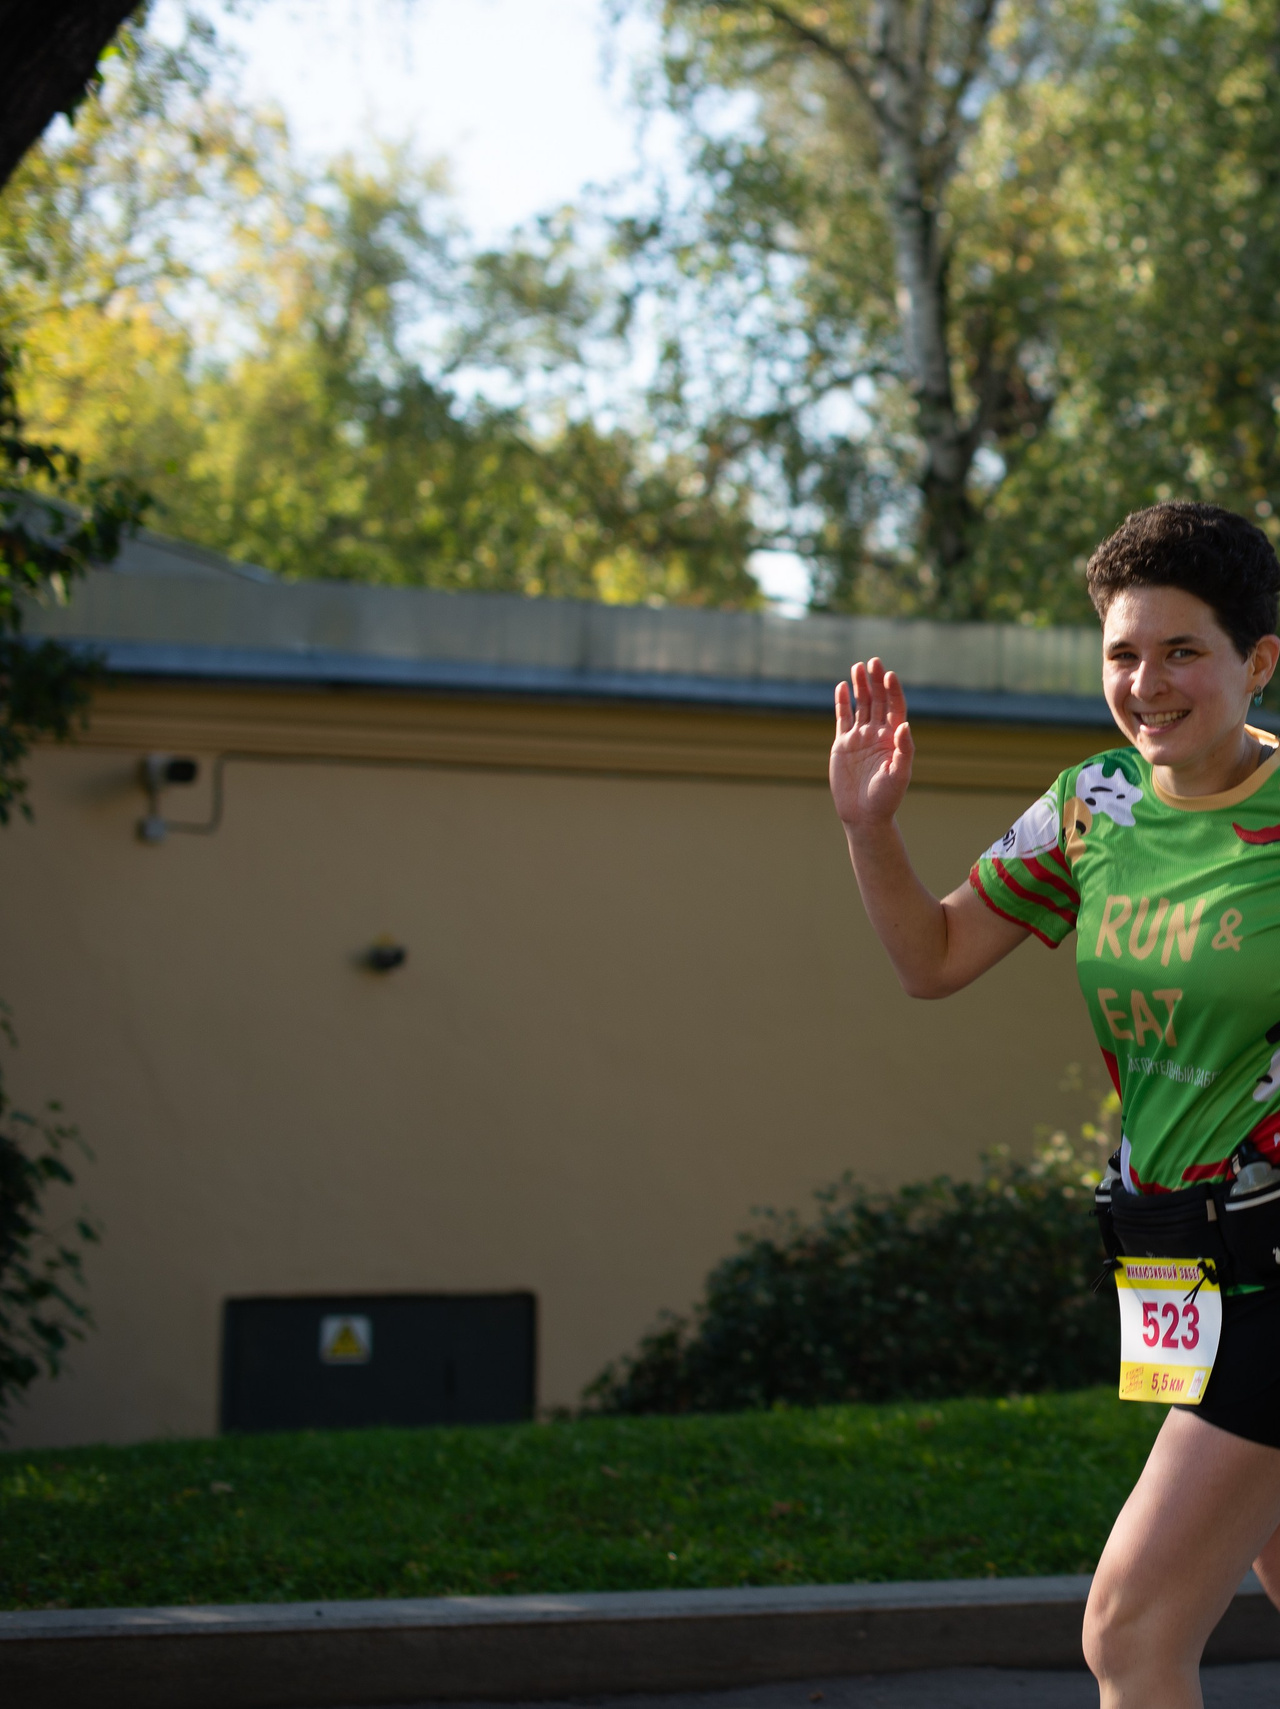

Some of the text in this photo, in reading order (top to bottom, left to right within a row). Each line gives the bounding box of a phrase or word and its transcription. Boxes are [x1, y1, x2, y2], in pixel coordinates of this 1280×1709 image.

[1095, 894, 1244, 968] RUN &
[1097, 987, 1184, 1047] EAT
[1126, 1263, 1201, 1281] ИНКЛЮЗИВНЫЙ ЗАБЕГ
[1142, 1301, 1200, 1350] 523
[1151, 1372, 1169, 1396] 5,5
